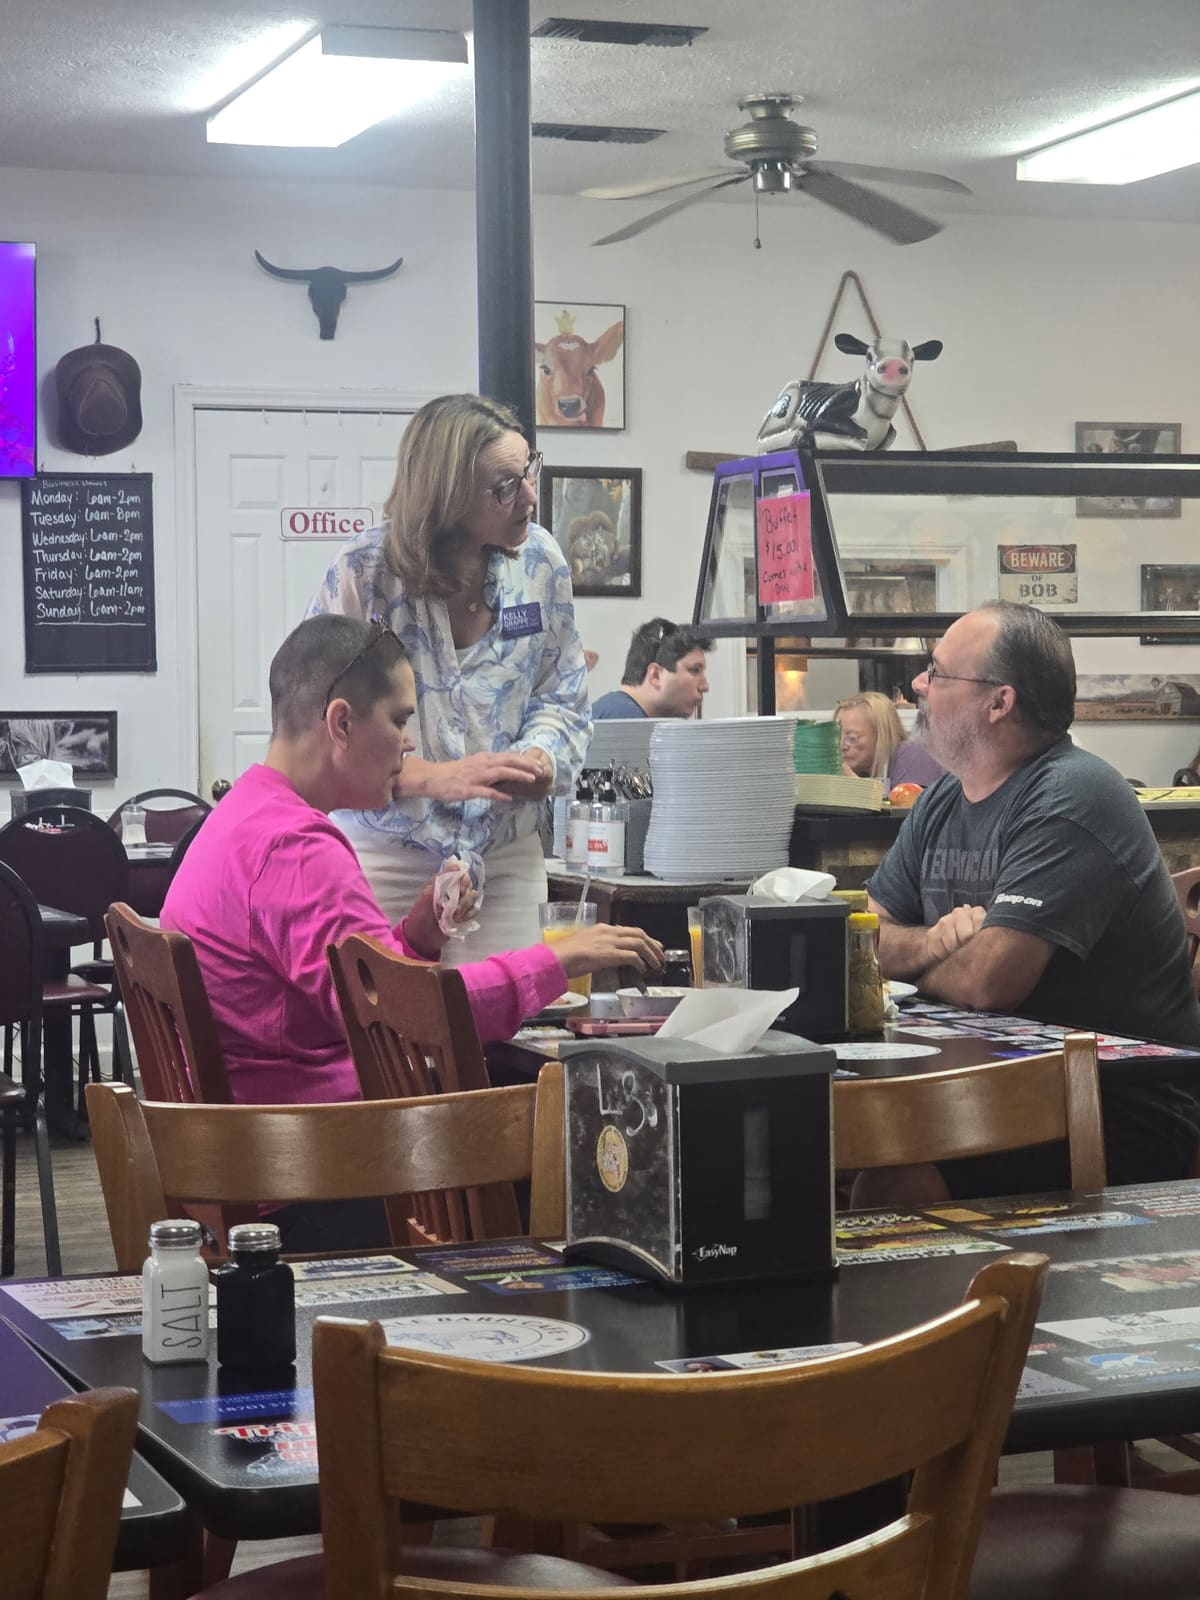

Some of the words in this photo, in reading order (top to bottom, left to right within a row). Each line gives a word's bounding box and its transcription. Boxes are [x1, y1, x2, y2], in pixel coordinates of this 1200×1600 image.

[31, 490, 79, 510] Monday:
[289, 511, 365, 534] Office
[1010, 552, 1066, 567] BEWARE
[35, 567, 77, 583] Friday:
[1031, 574, 1042, 582] OF
[1019, 583, 1058, 597] BOB
[36, 602, 85, 621] Sunday:
[160, 1283, 202, 1349] SALT
